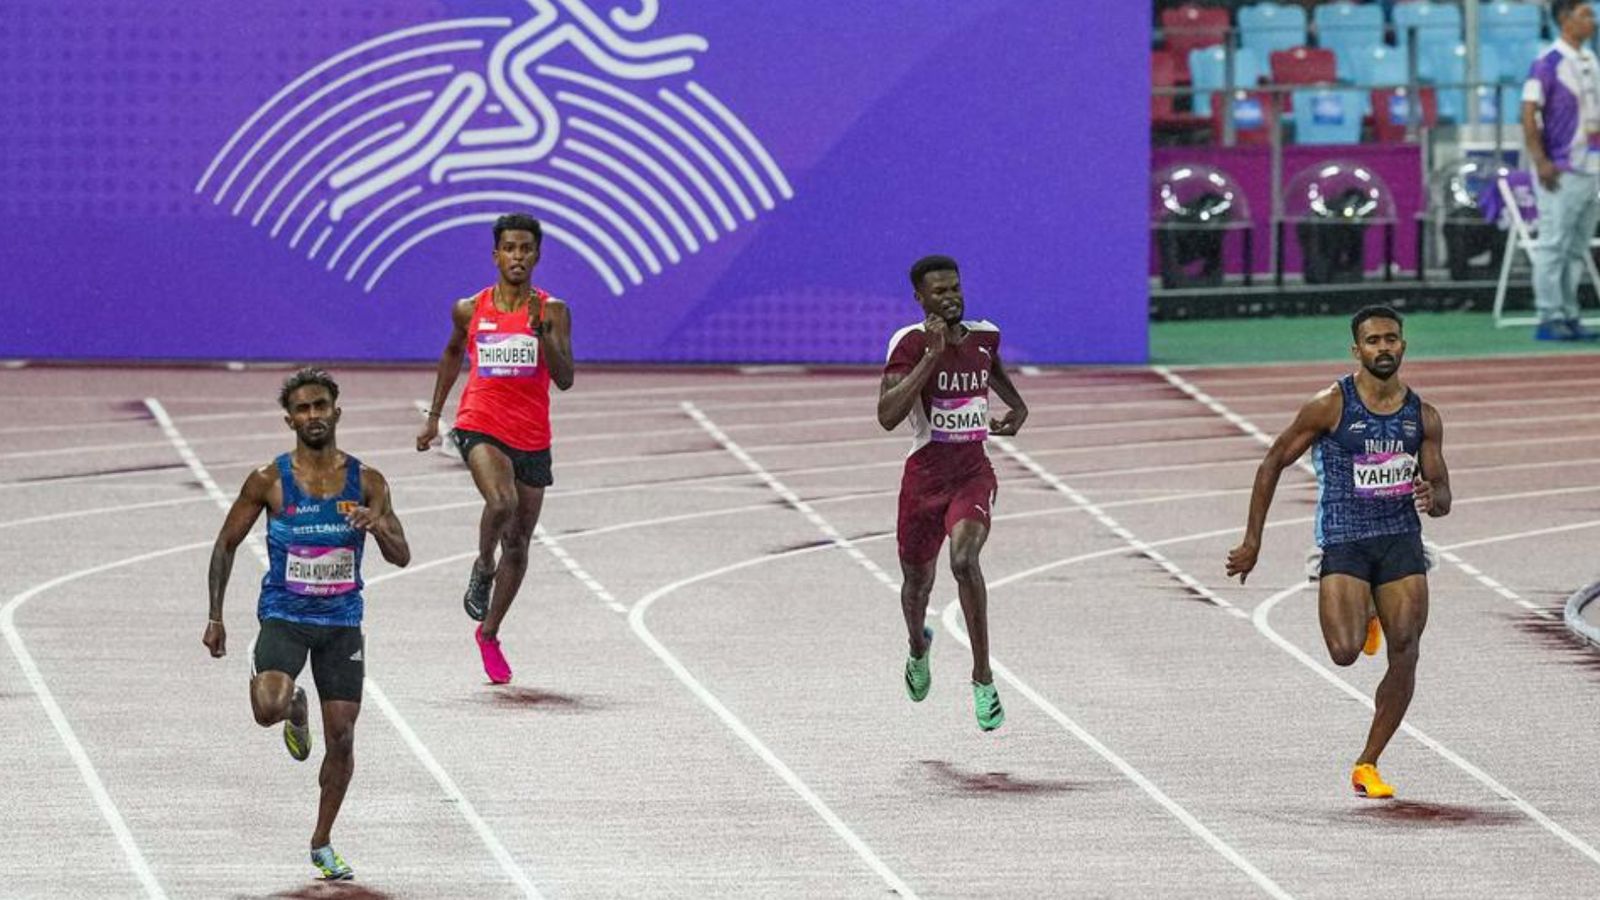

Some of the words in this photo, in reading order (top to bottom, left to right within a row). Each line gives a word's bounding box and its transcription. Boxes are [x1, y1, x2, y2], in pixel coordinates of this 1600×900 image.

[479, 347, 536, 364] THIRUBEN
[937, 369, 989, 392] QATAR
[1364, 438, 1405, 455] INDIA
[1356, 466, 1413, 485] YAHIYA
[287, 561, 312, 578] HEWA
